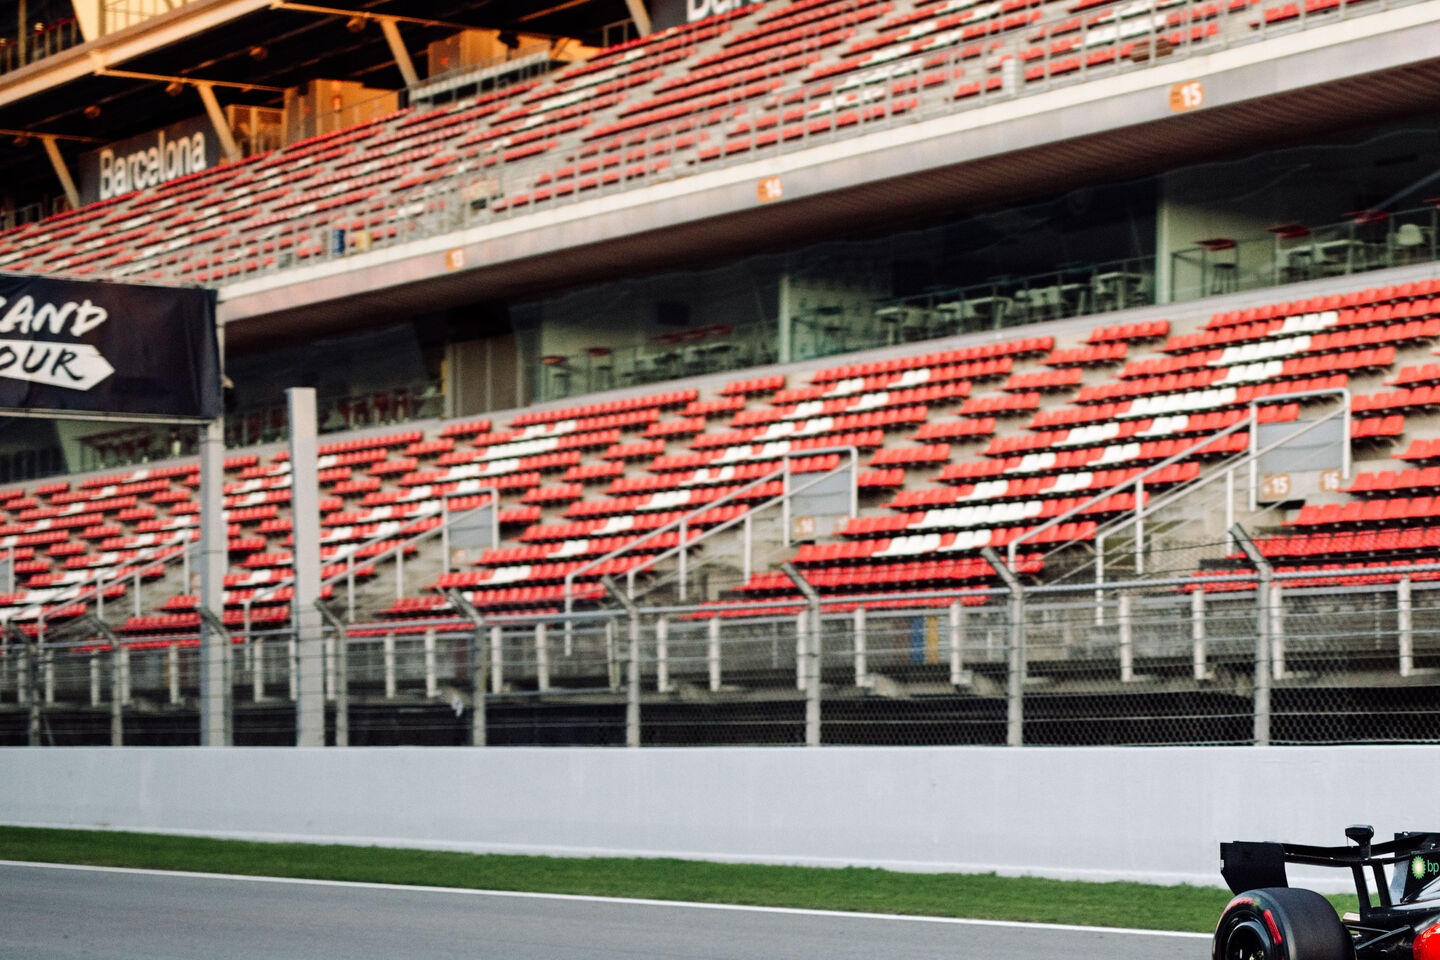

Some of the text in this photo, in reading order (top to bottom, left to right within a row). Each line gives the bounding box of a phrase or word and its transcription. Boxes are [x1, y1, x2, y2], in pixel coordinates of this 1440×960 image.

[1181, 83, 1202, 107] 15
[100, 130, 206, 199] Barcelona
[0, 294, 108, 337] AND
[1272, 476, 1288, 494] 15
[1427, 859, 1440, 876] bp
